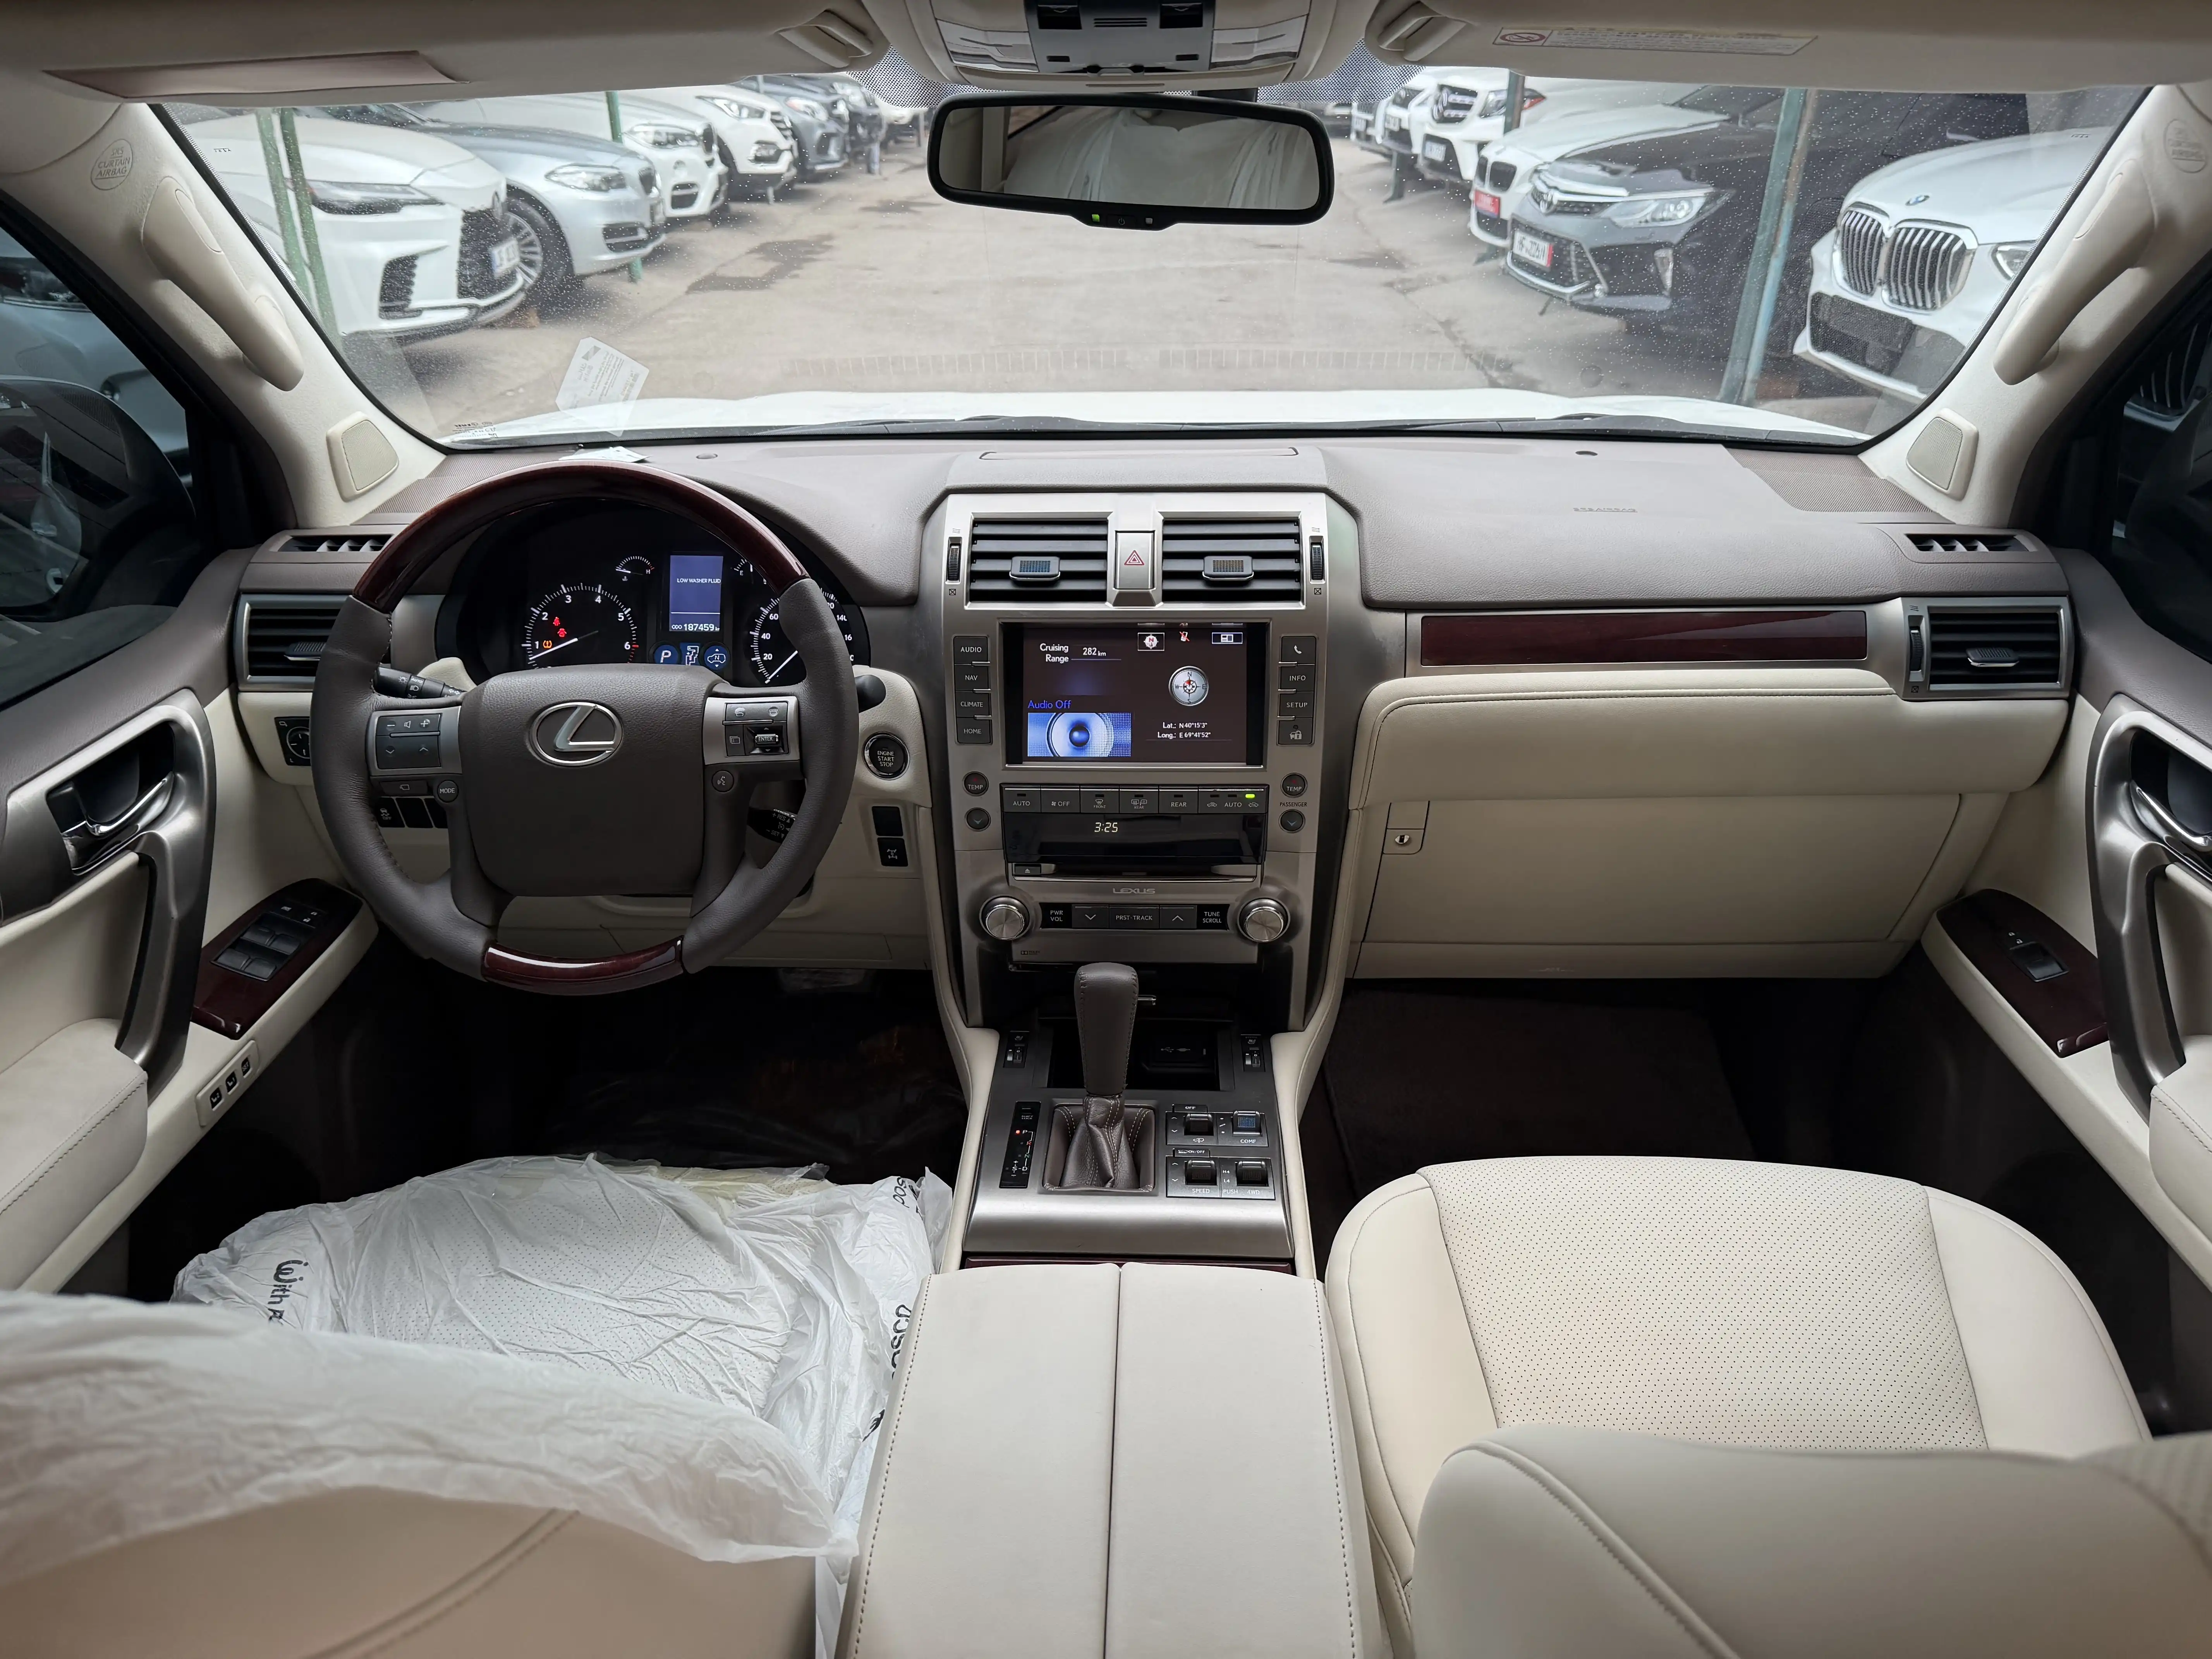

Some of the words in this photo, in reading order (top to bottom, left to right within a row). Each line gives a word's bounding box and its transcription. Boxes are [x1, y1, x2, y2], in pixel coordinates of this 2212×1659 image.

[98, 157, 131, 168] CURTAIN
[97, 167, 127, 177] AIRBAG
[565, 595, 572, 603] 3
[595, 595, 601, 604] 4
[542, 612, 548, 620] 2
[618, 613, 624, 621] 5
[535, 641, 539, 649] 1
[624, 641, 631, 650] 6
[1040, 643, 1069, 653] Cruising
[660, 650, 671, 663] P
[1046, 654, 1069, 663] Range
[1028, 700, 1053, 709] Audio
[1055, 700, 1071, 709] Off
[1094, 822, 1118, 832] 3:25
